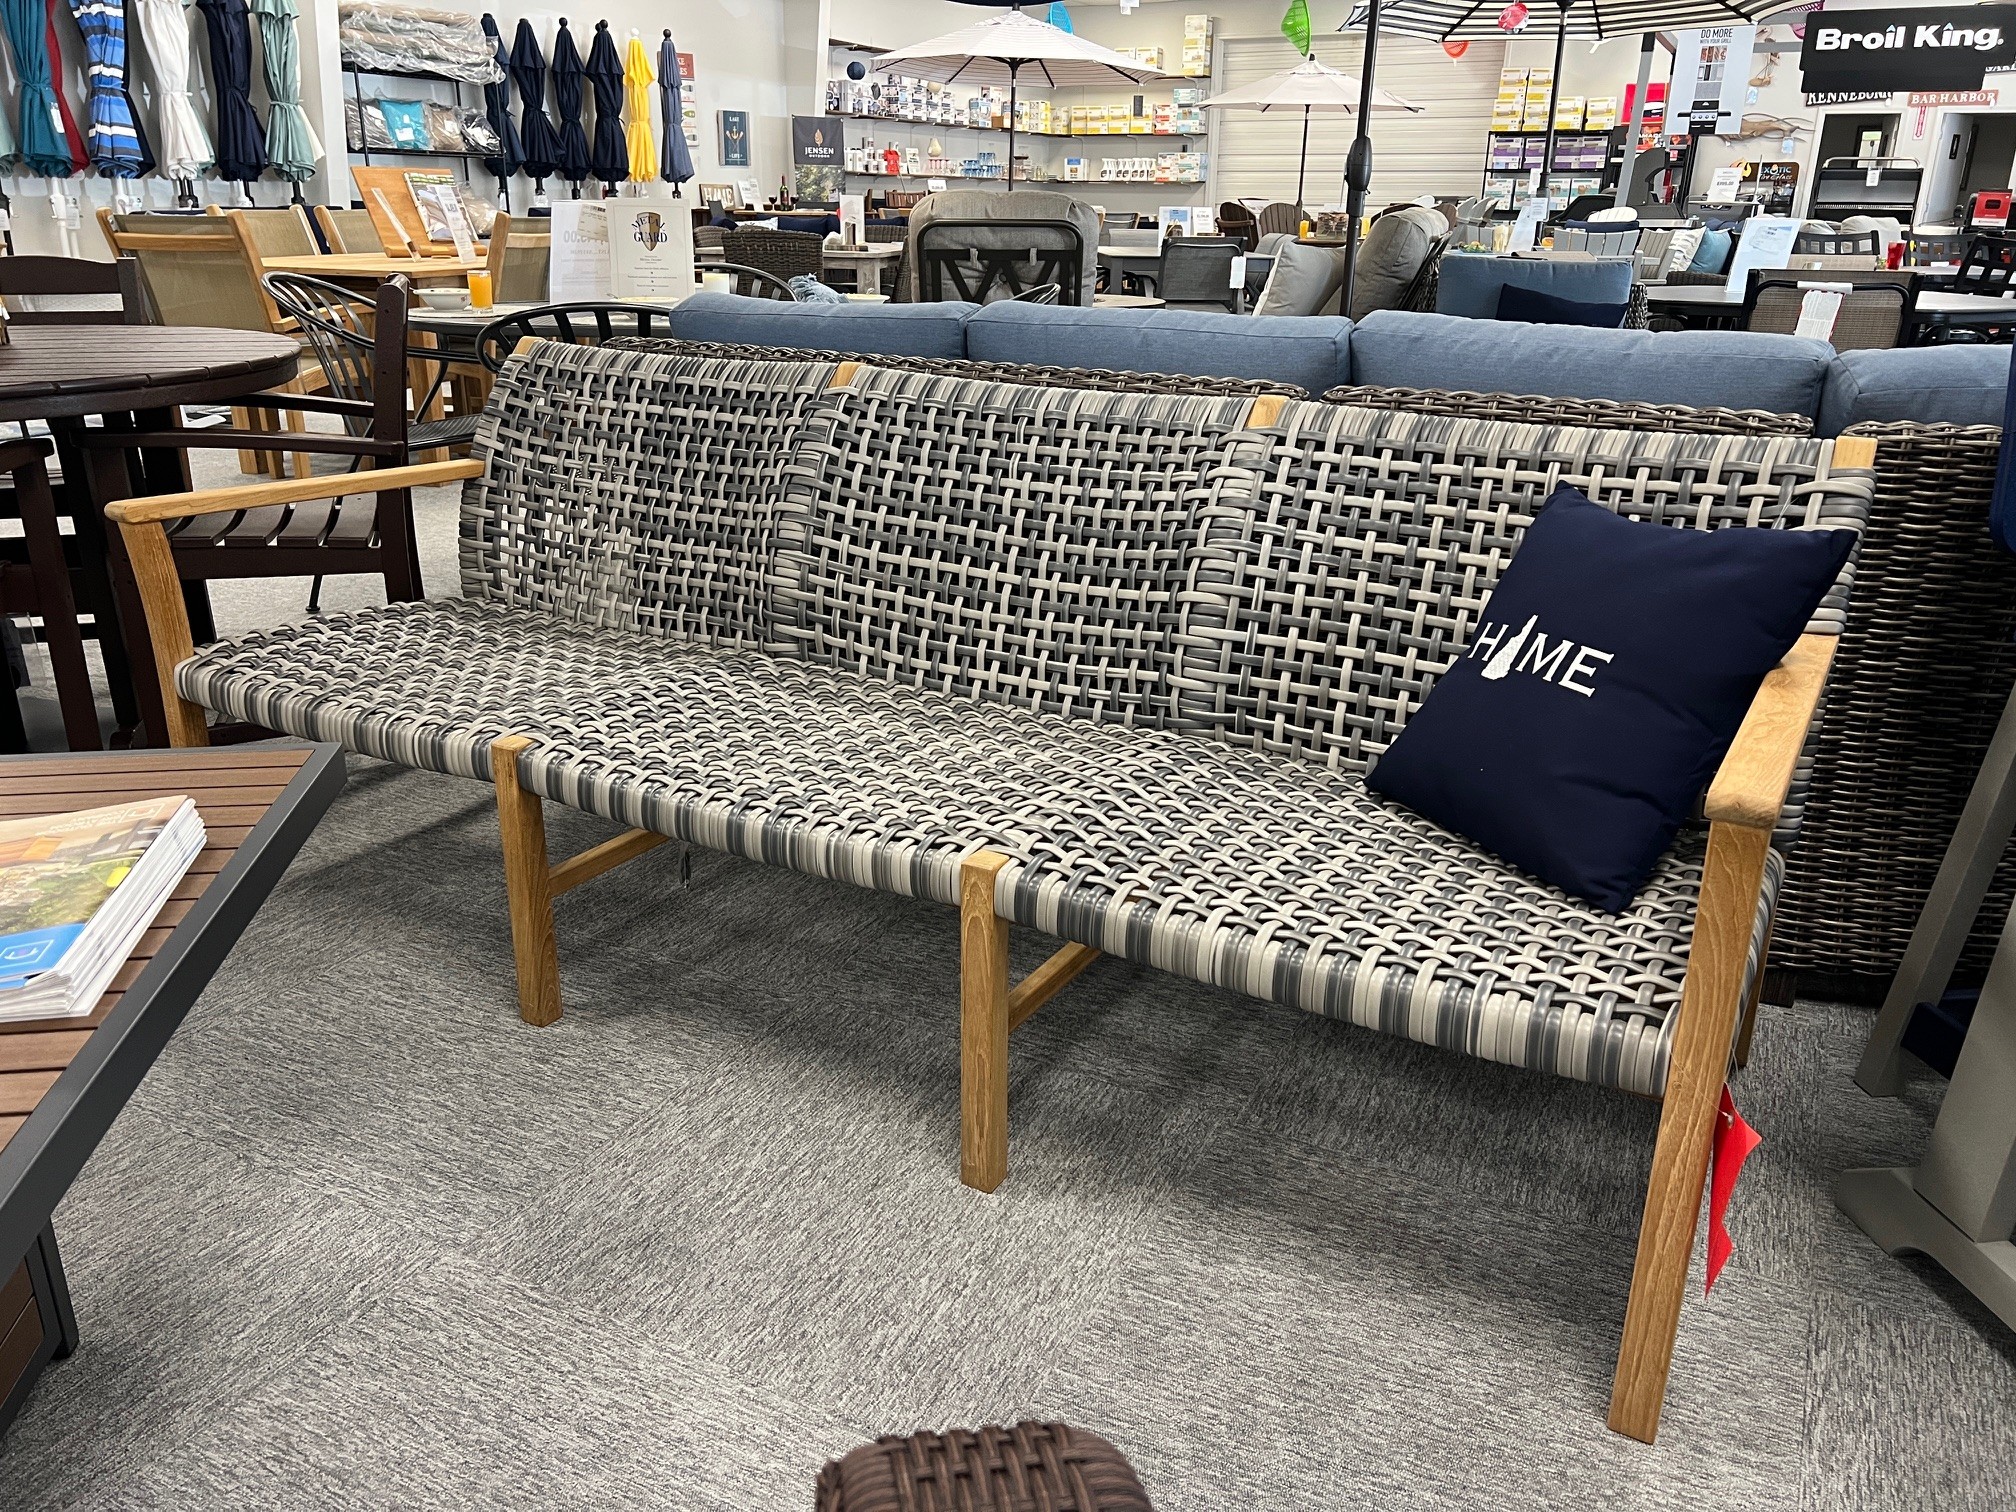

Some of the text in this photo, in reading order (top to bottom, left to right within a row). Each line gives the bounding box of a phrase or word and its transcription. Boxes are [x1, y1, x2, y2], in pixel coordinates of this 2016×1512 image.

[1701, 28, 1733, 38] DO MORE
[1911, 92, 1996, 104] BAR HARBOR
[804, 146, 834, 155] JENSEN
[1760, 165, 1792, 174] XOTIC
[633, 231, 668, 243] GUARD
